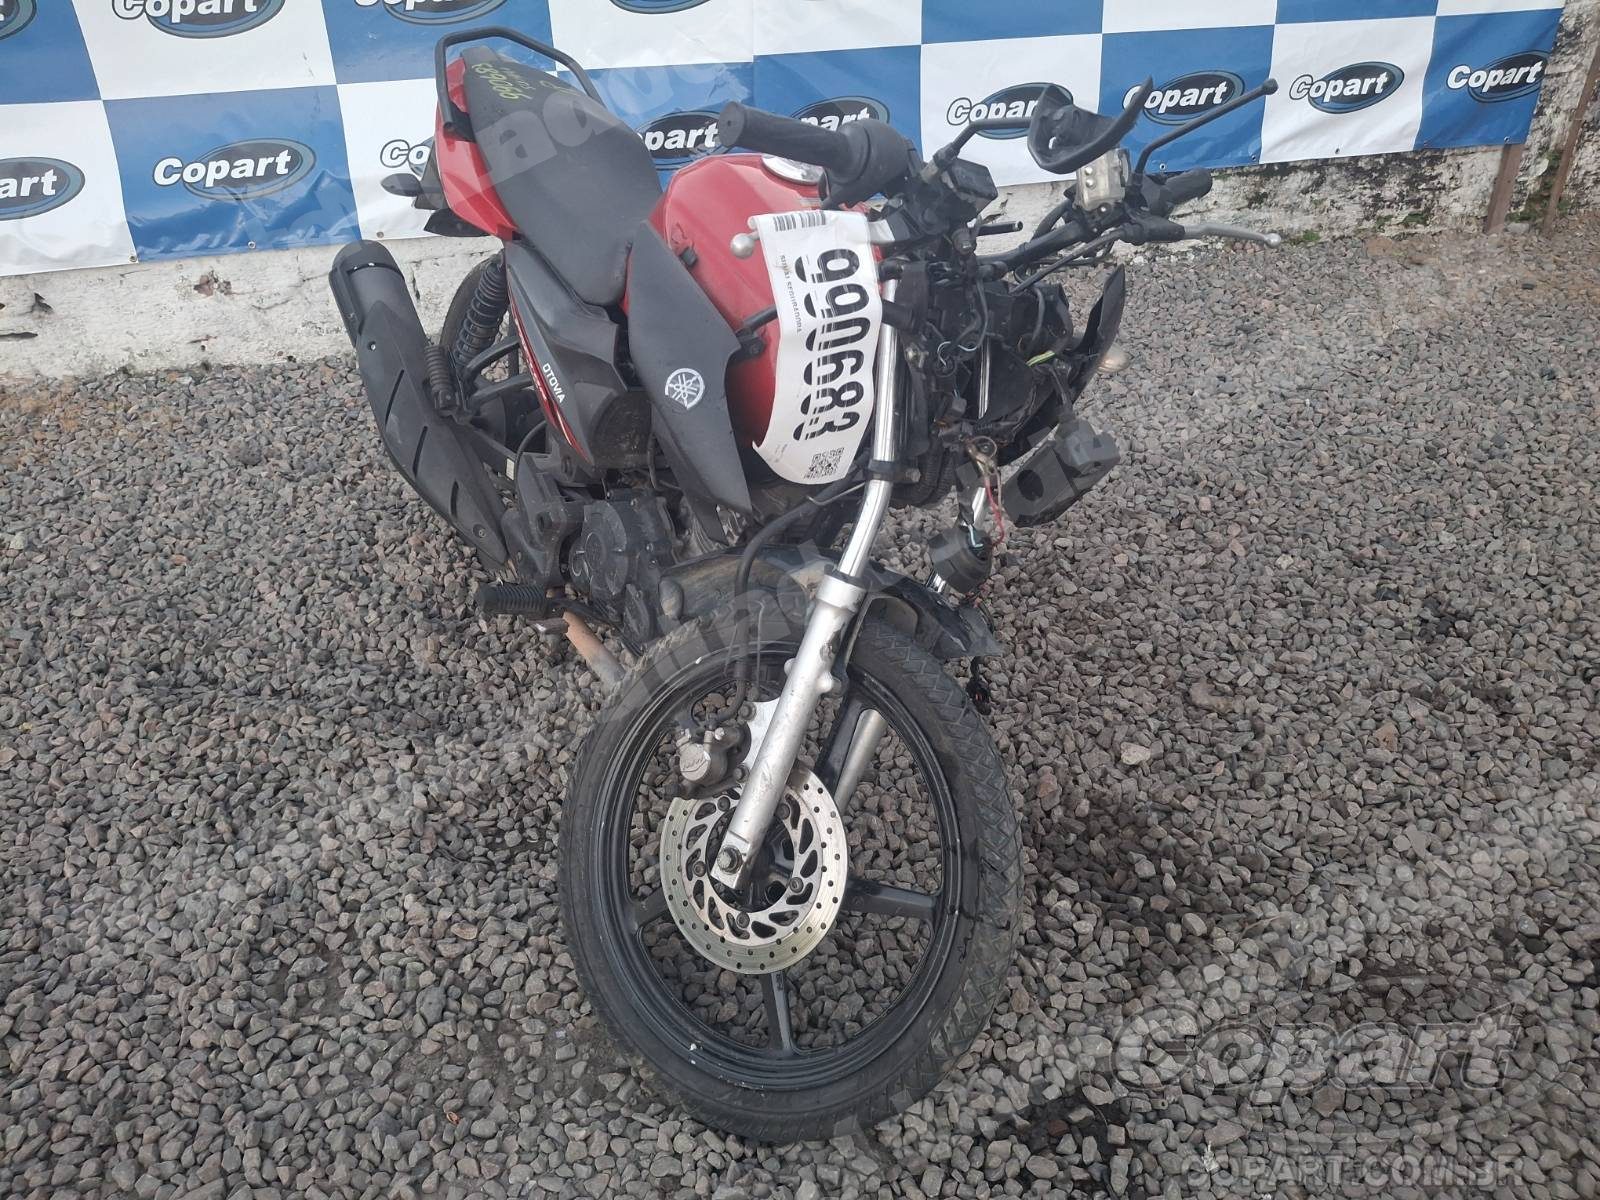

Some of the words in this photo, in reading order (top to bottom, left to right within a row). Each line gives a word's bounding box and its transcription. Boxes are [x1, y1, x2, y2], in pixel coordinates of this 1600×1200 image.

[1289, 72, 1388, 102] Copart
[1447, 61, 1543, 92] Copart
[947, 98, 1038, 125] Copar
[637, 123, 718, 150] part
[153, 150, 291, 187] Copart
[793, 249, 871, 441] 990683
